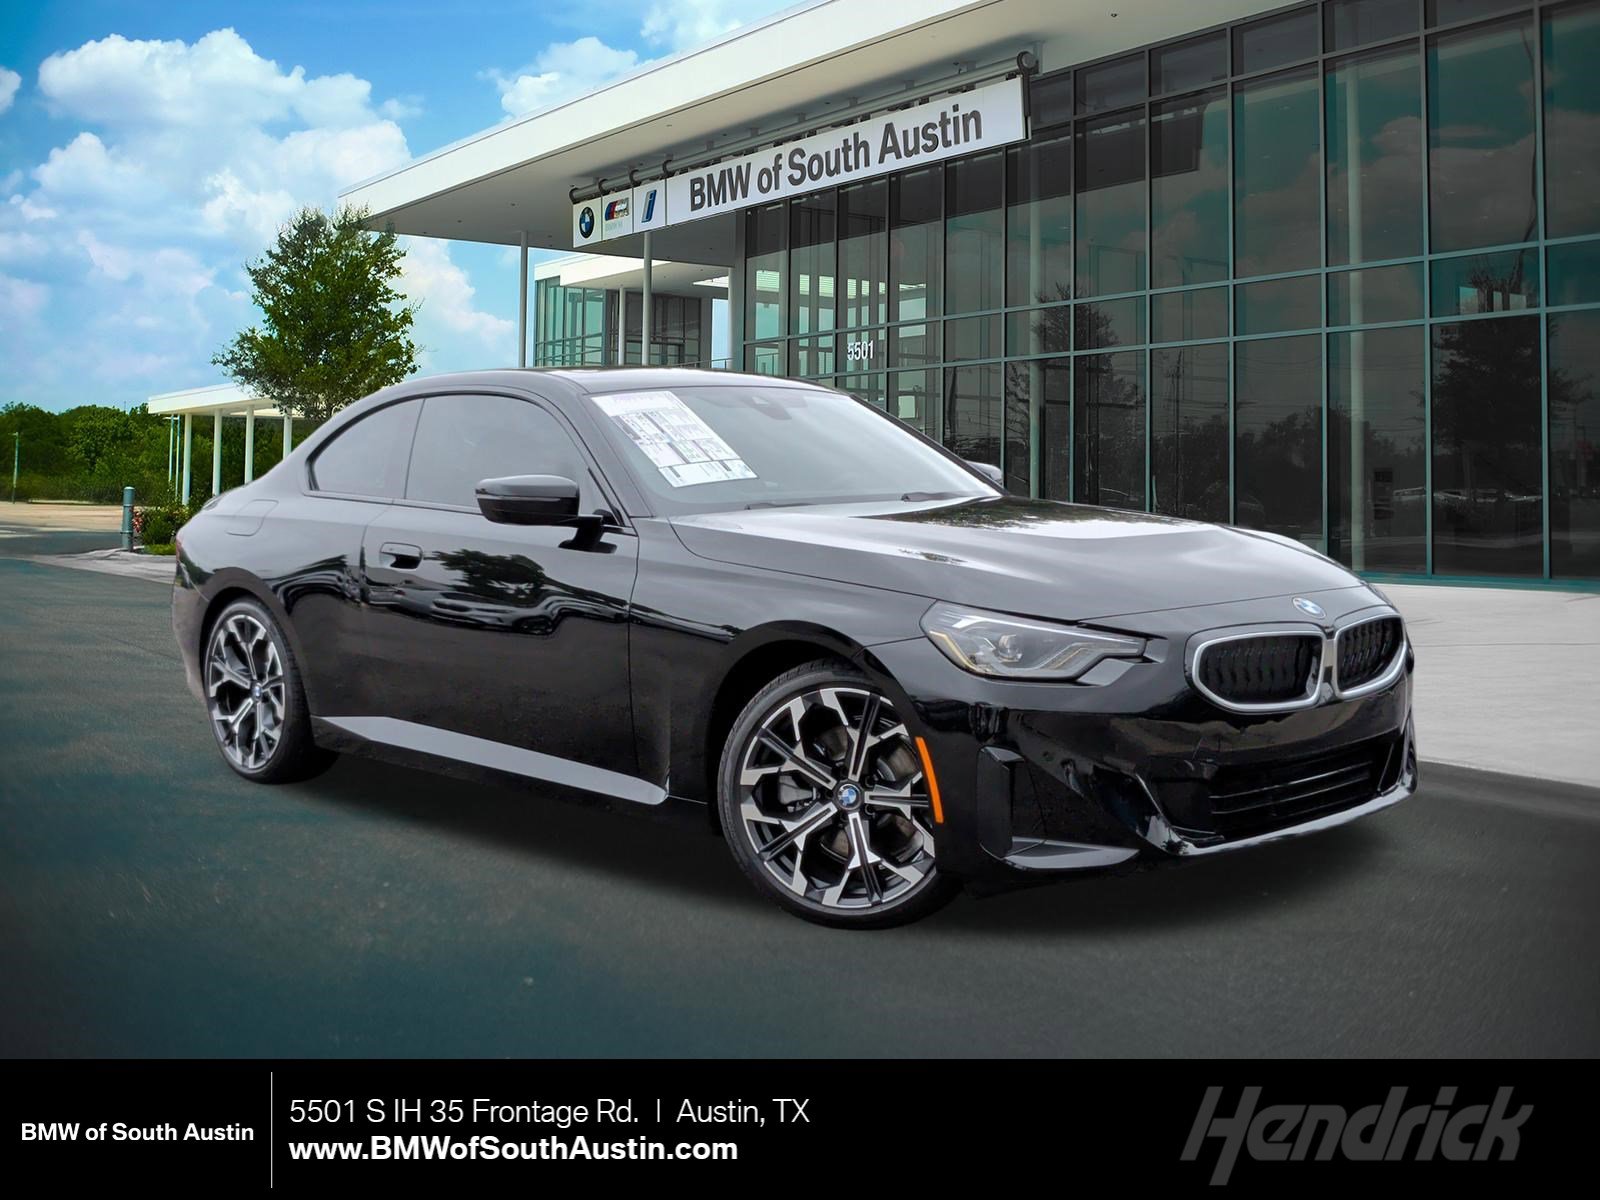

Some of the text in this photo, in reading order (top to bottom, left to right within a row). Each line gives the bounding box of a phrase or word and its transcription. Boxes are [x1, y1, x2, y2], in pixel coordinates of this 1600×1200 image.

[690, 164, 751, 211] BMW
[757, 154, 783, 194] of
[787, 132, 871, 186] South
[878, 104, 983, 164] Austin
[847, 340, 874, 361] 5501
